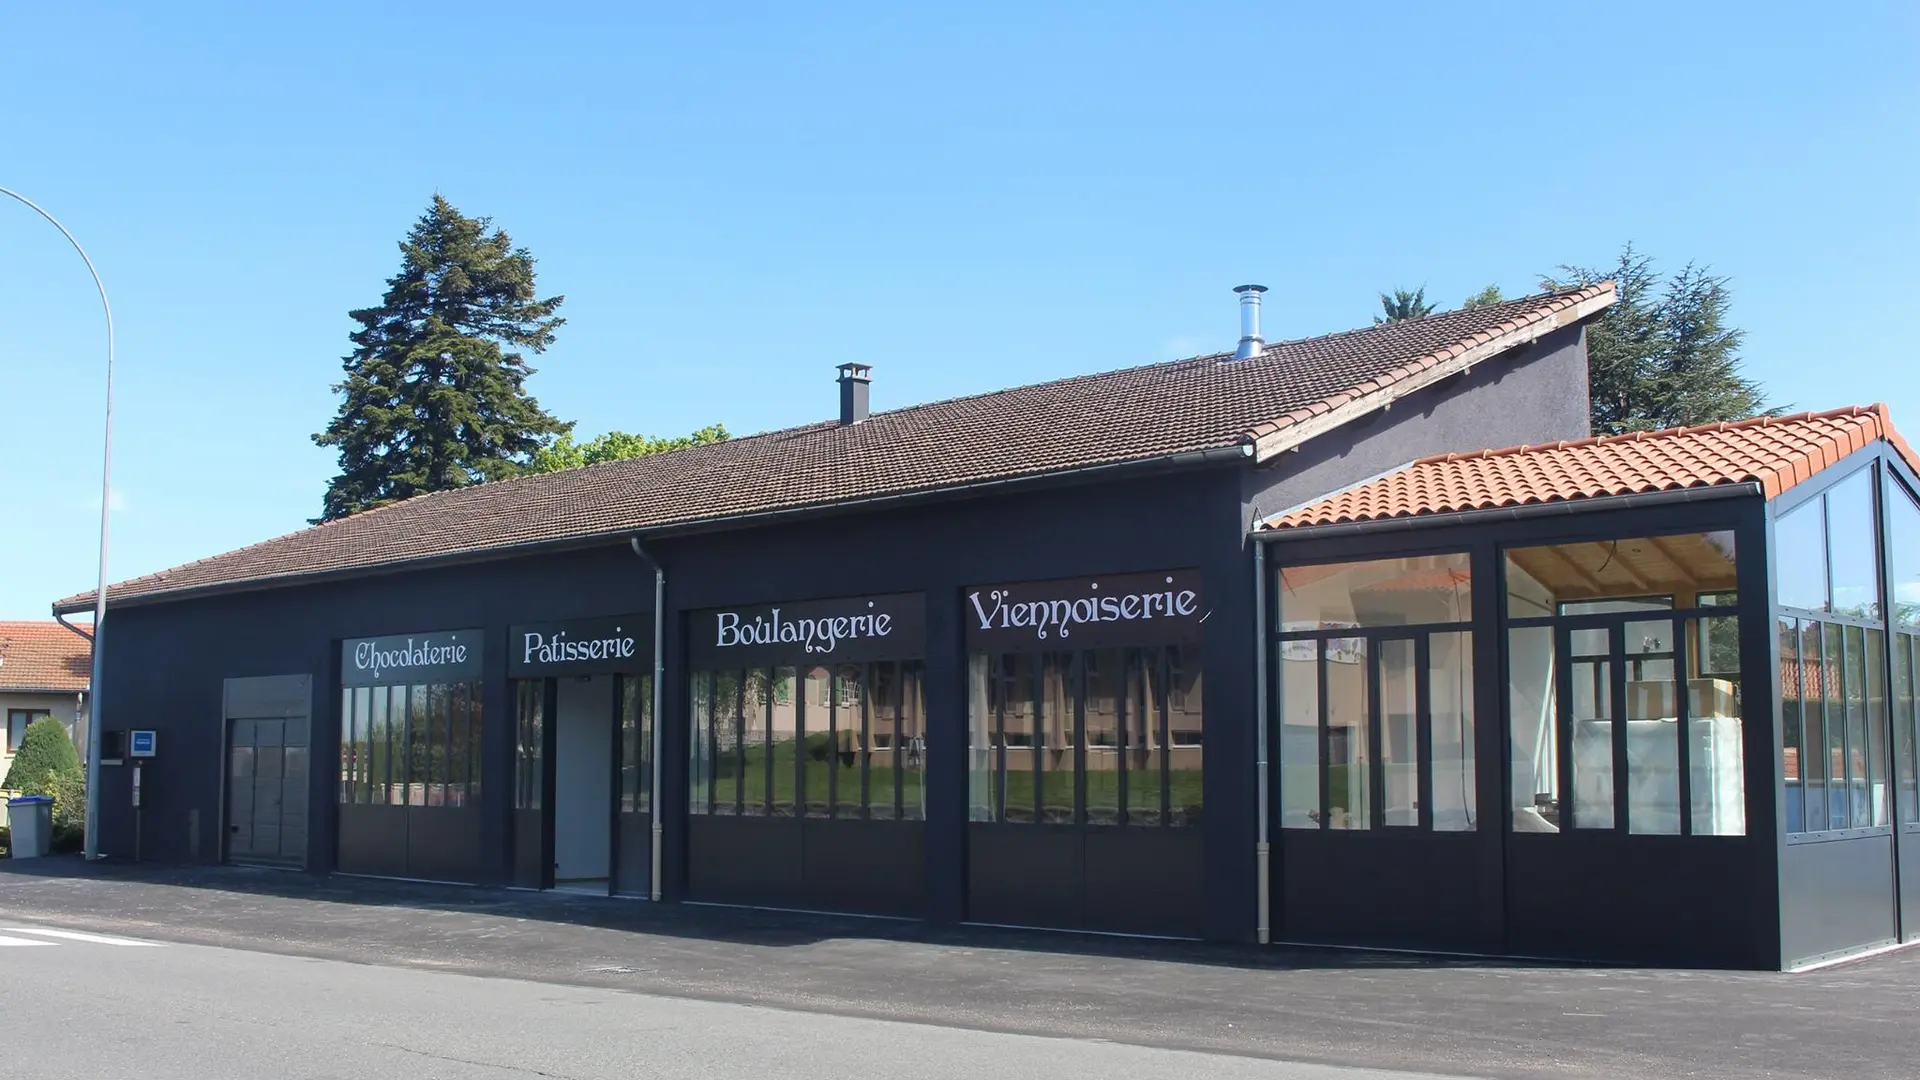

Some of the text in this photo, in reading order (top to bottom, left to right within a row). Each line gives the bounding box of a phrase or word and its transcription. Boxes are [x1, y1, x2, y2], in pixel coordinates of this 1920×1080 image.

[716, 601, 892, 653] Boulangerie
[969, 576, 1198, 640] Viennoiserie
[354, 635, 468, 679] Chocolaterie
[523, 626, 635, 664] Patisserie
